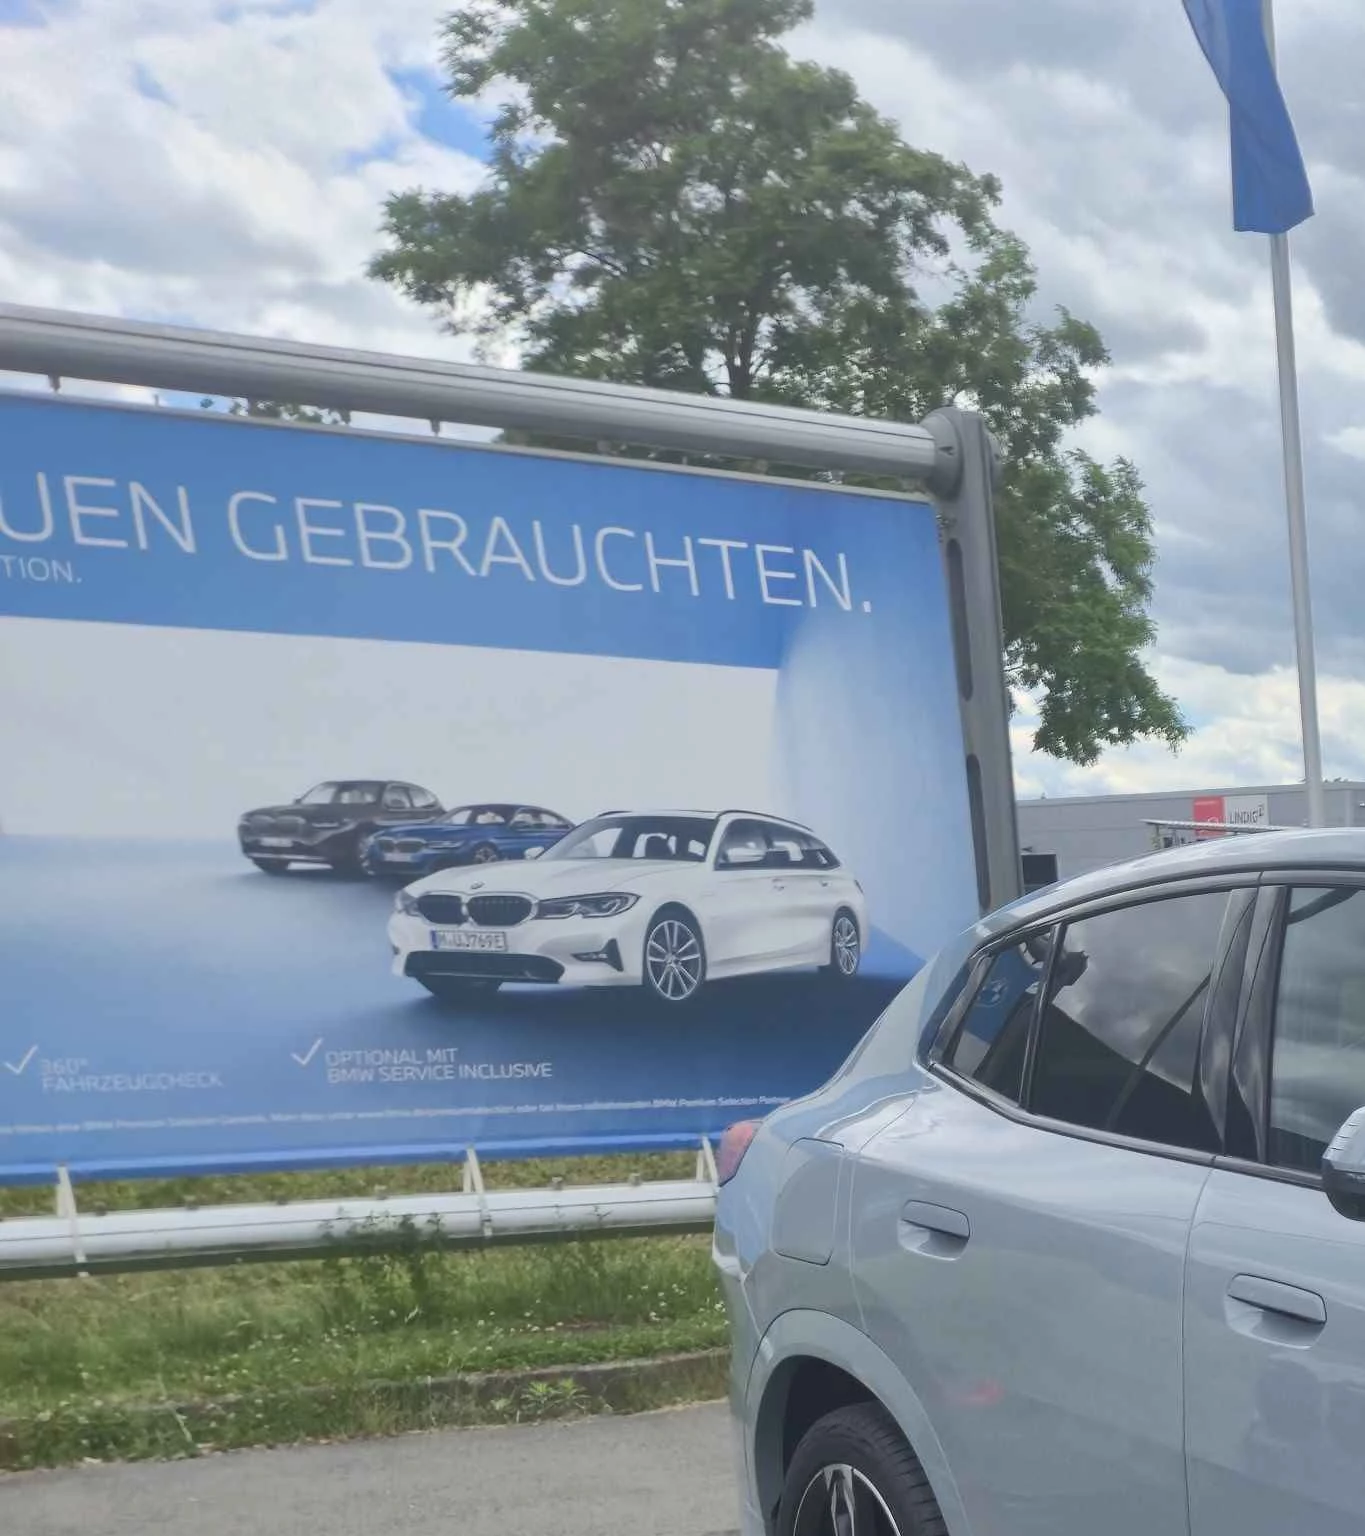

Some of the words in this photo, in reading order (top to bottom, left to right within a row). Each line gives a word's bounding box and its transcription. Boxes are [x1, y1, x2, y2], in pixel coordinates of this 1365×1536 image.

[0, 472, 196, 553] UEN
[227, 490, 872, 614] GEBRAUCHTEN.
[0, 553, 83, 584] TION.
[325, 1049, 422, 1067] OPTIONAL
[427, 1047, 459, 1063] MIT
[41, 1072, 224, 1092] FAHRZEUGCHECK
[327, 1066, 374, 1084] BMW
[380, 1064, 455, 1082] SERVICE
[459, 1062, 553, 1080] INCLUSIVE
